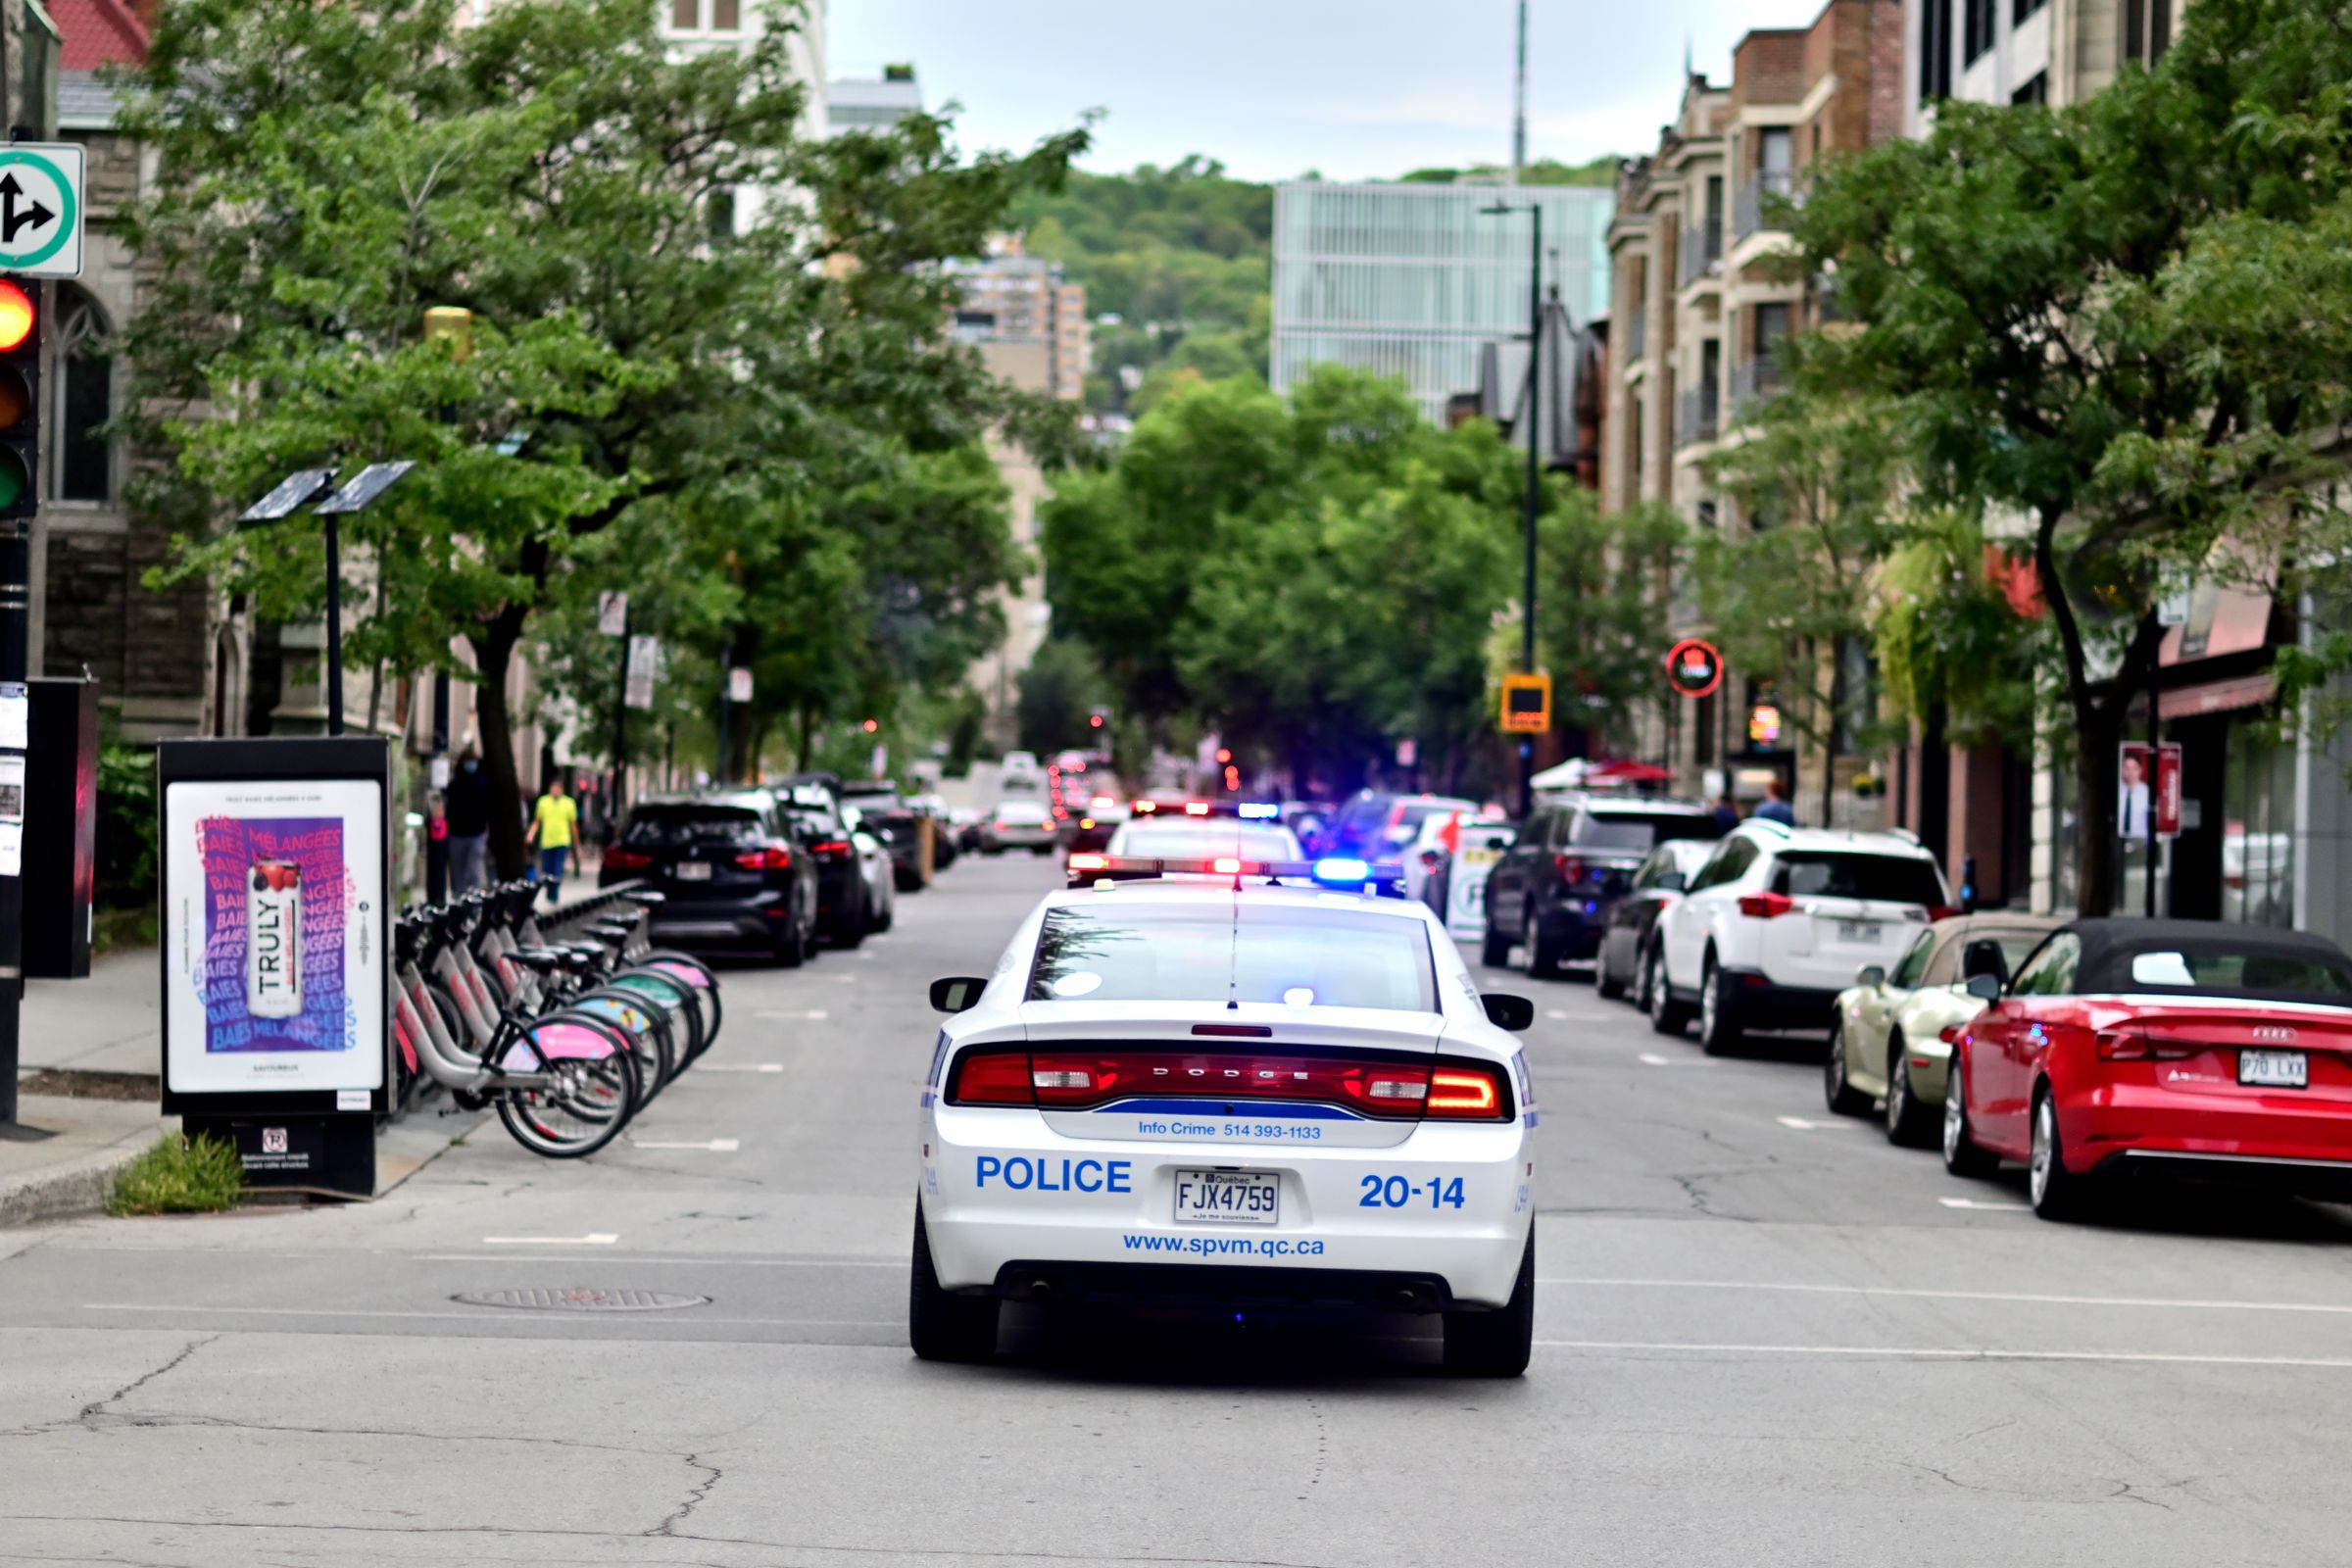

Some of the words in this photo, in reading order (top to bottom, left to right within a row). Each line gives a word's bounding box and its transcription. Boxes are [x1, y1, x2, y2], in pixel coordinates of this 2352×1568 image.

[258, 900, 279, 995] TRULY
[1152, 1067, 1308, 1080] DODGE
[1139, 1121, 1167, 1135] Info
[1171, 1121, 1215, 1136] Crime
[1224, 1124, 1250, 1137] 514
[1254, 1124, 1321, 1139] 393-1133
[976, 1155, 1131, 1194] POLICE
[1179, 1183, 1275, 1212] FJX4759
[1358, 1174, 1465, 1209] 20-14
[1123, 1235, 1324, 1258] www.spvm.qc.ca
